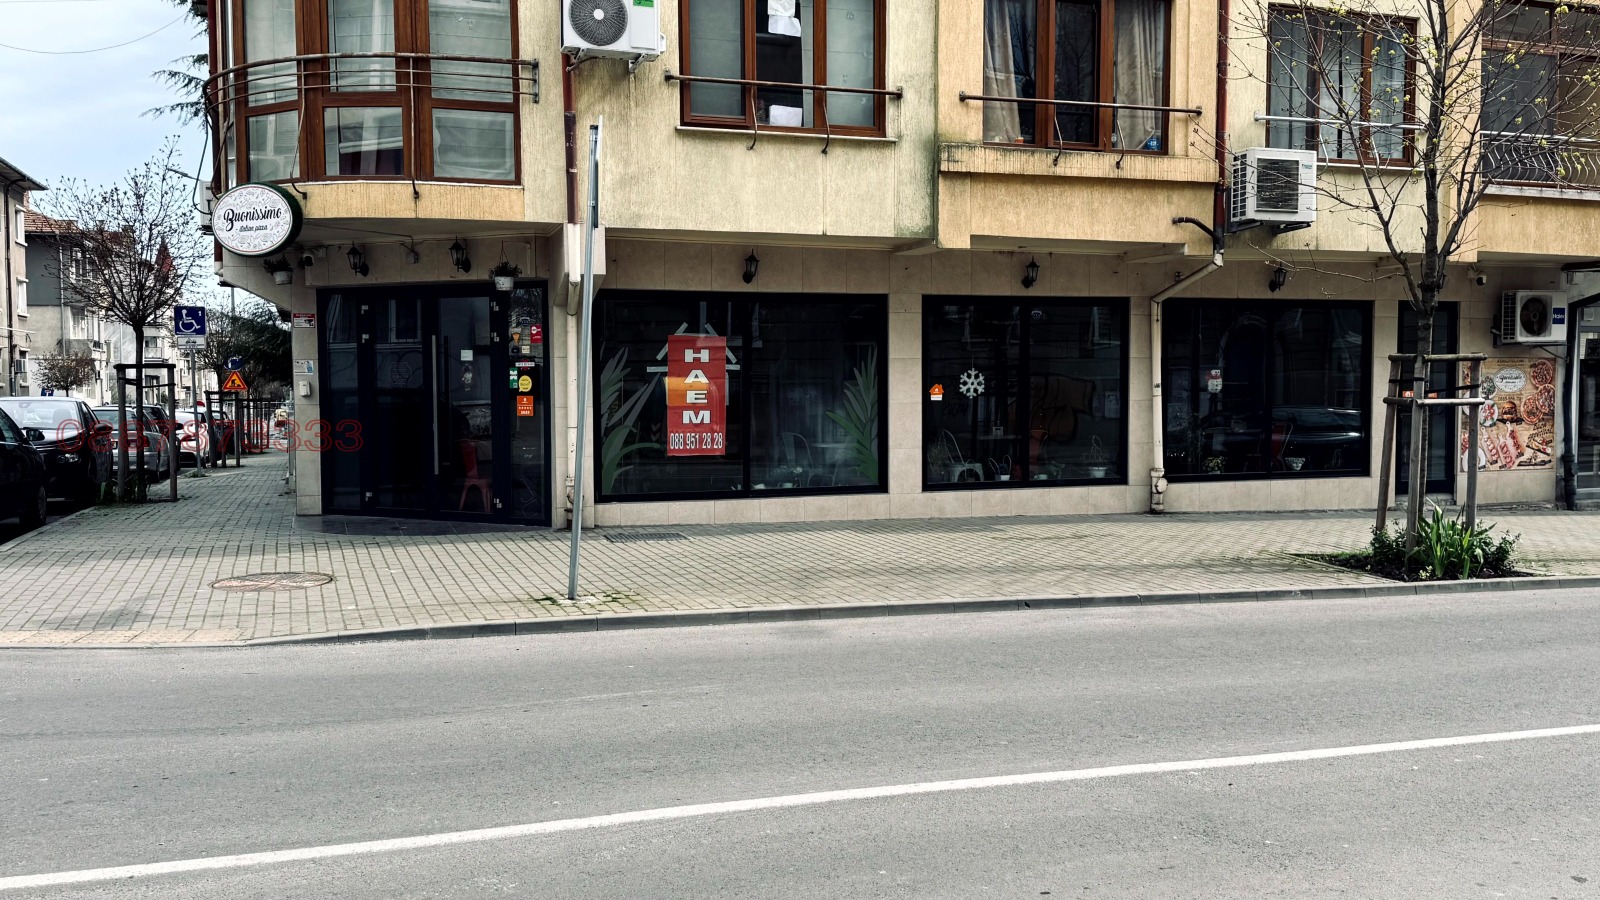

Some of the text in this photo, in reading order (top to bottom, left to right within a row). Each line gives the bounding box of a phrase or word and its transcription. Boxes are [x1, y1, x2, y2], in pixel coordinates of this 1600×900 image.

[223, 206, 282, 232] Buonissimo
[682, 349, 711, 424] НАЕМ
[670, 433, 723, 449] 088 951 28 28
